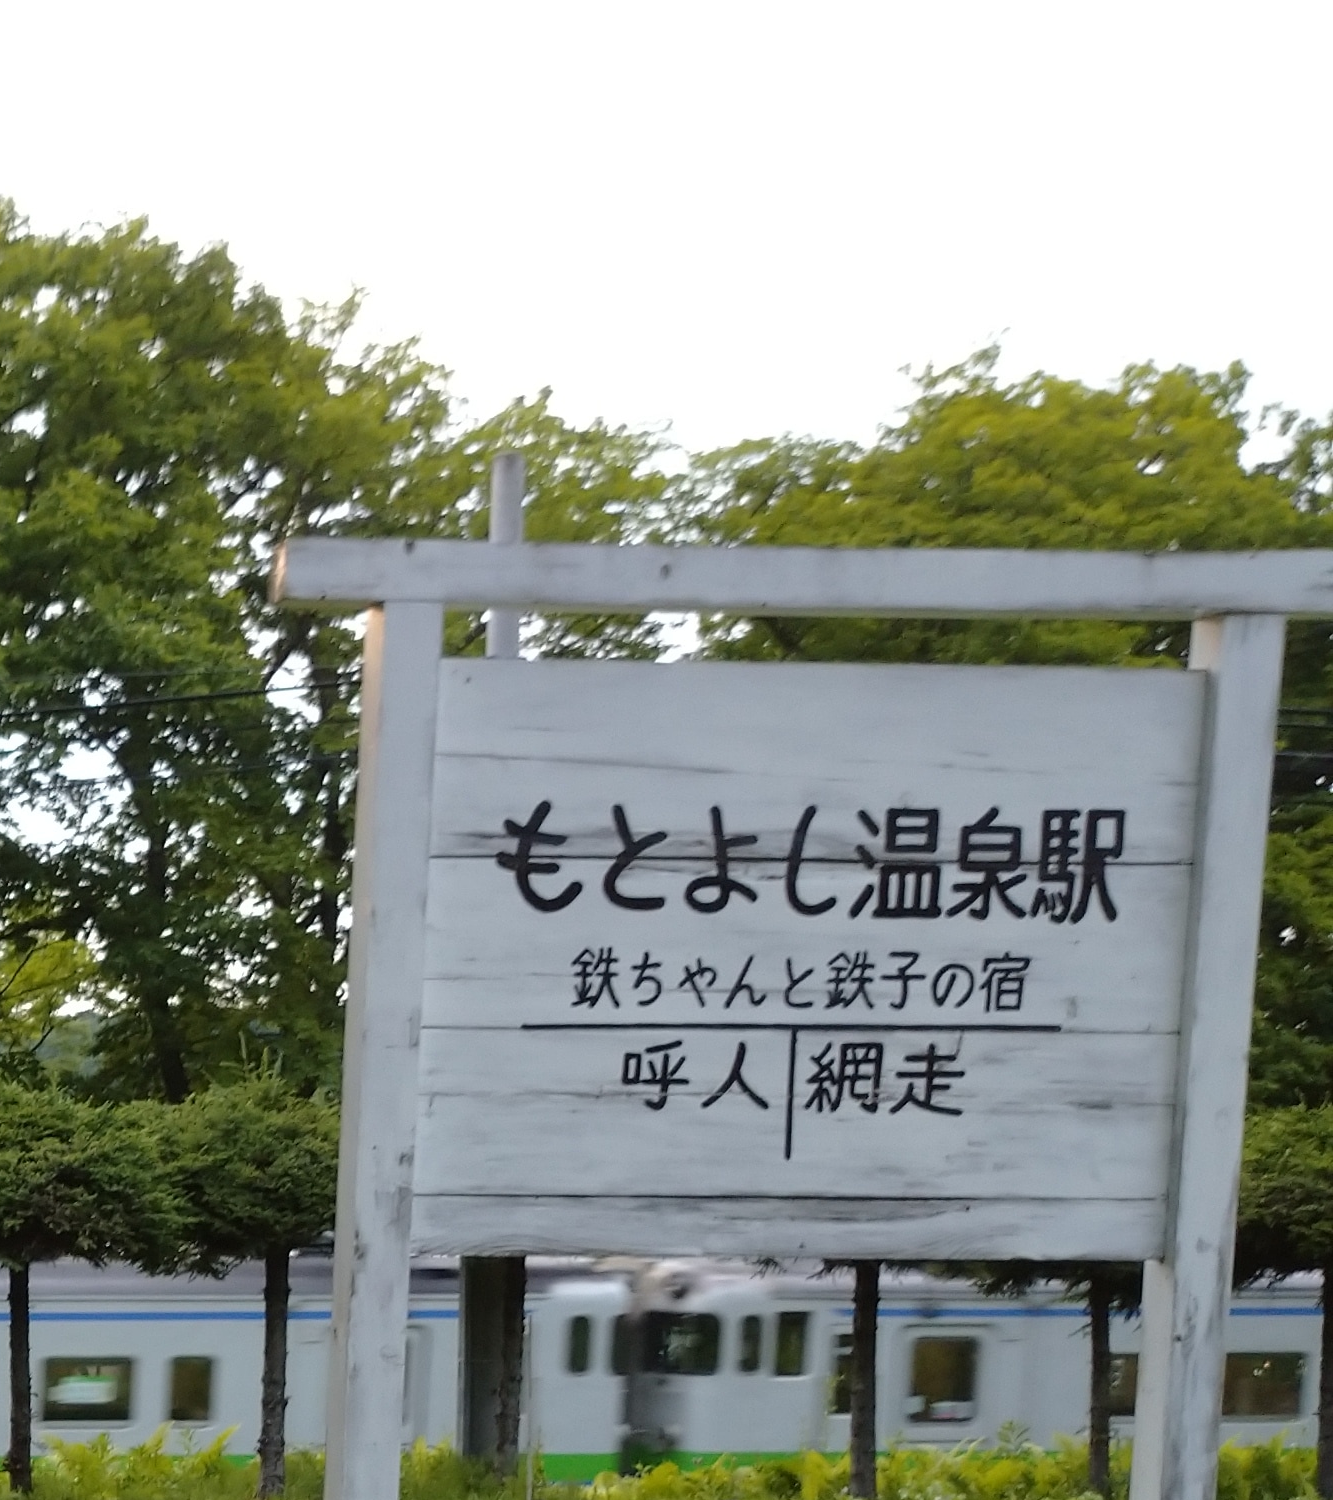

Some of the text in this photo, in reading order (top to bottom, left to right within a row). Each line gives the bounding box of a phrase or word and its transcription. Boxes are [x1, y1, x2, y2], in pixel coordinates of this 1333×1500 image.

[496, 801, 1126, 924] もとよし温泉駅
[570, 945, 1033, 1014] 鉄ちゃんと鉄子の宿
[620, 1040, 966, 1117] 呼人 網走
